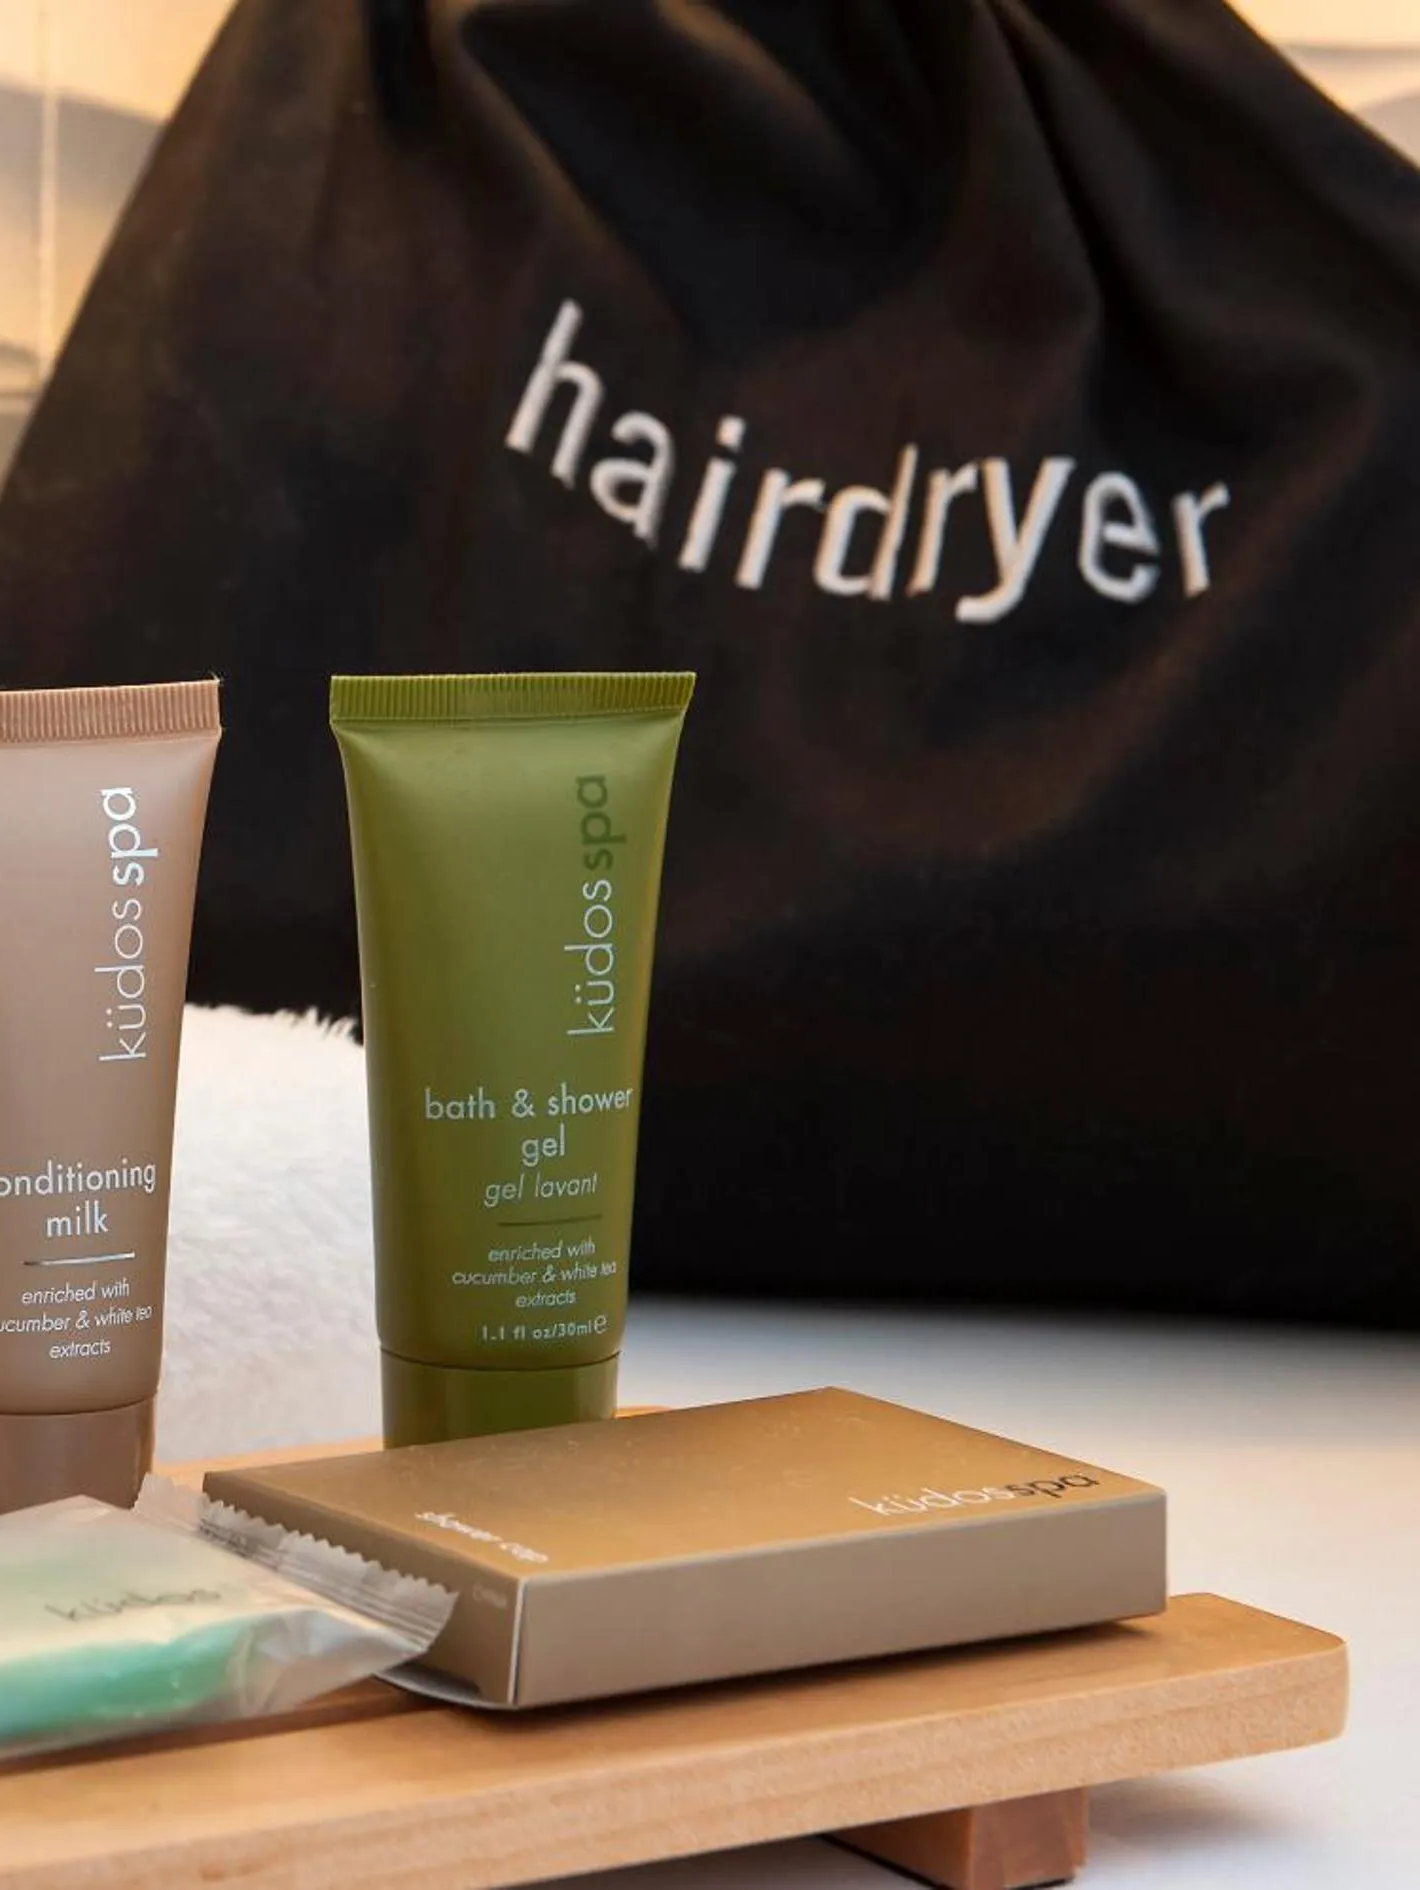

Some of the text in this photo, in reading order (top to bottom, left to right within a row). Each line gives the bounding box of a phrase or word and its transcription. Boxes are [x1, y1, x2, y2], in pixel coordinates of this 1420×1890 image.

[505, 299, 1229, 623] hairdryer
[564, 774, 628, 1035] küdos spa
[94, 787, 159, 1061] küdos spa
[424, 1082, 633, 1120] bath & shower
[521, 1122, 566, 1167] gel
[483, 1171, 598, 1208] gel lavant
[46, 1200, 109, 1237] milk
[488, 1235, 595, 1263] enriched with
[21, 1276, 130, 1304] enriched with
[451, 1266, 537, 1286] cucumber
[541, 1264, 557, 1284] &
[515, 1289, 576, 1308] extracts
[74, 1309, 91, 1330] &
[94, 1305, 133, 1328] white
[512, 1325, 526, 1340] fl
[49, 1338, 111, 1359] extracts
